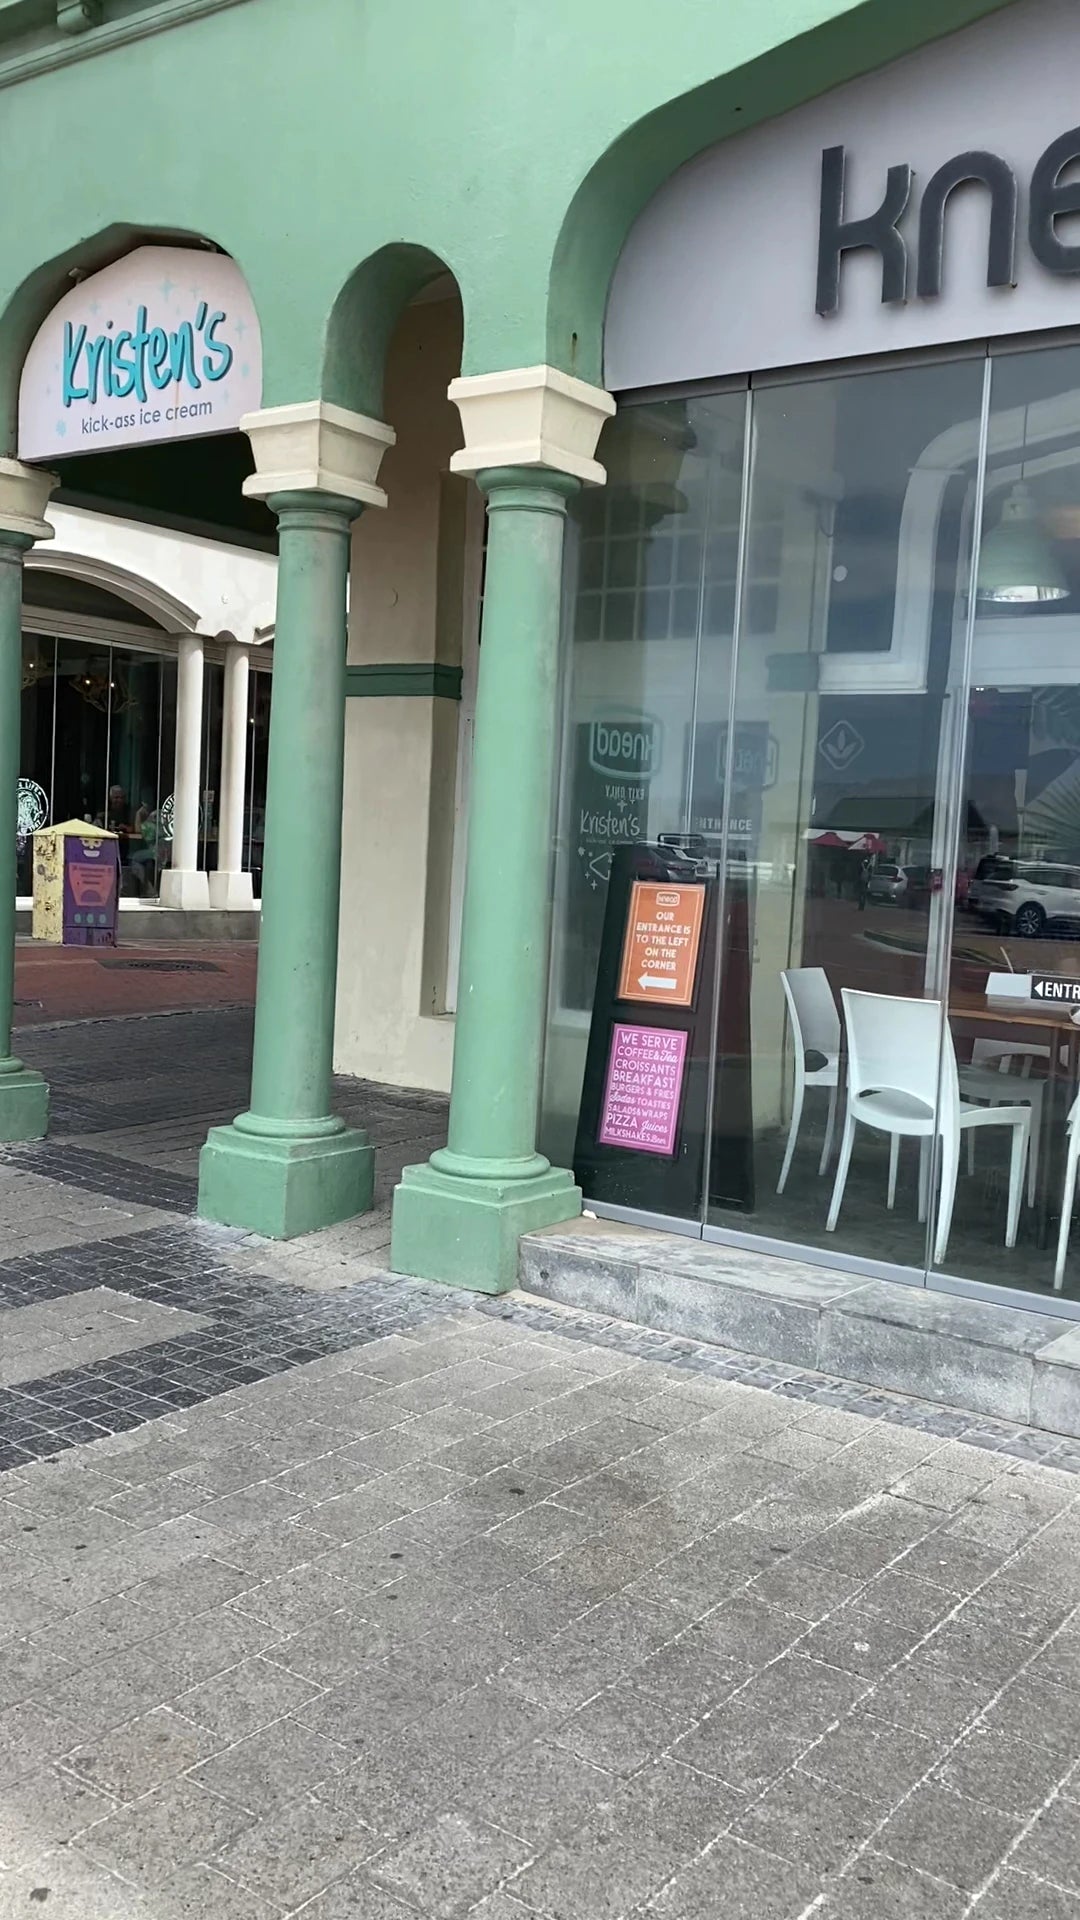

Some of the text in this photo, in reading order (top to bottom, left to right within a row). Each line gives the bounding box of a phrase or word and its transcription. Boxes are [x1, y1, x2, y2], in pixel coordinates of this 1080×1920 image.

[63, 301, 233, 408] Kristen's
[81, 401, 213, 435] kick-ass ice cream
[580, 808, 641, 838] Kristen's
[695, 817, 752, 831] NTRNCE
[656, 911, 675, 921] OUR
[636, 922, 692, 935] ENTRANCE IS
[636, 934, 689, 947] TO THE LEFT
[645, 947, 677, 958] ON THE
[641, 959, 677, 971] CORNER
[1044, 981, 1080, 1000] ENTR
[621, 1032, 679, 1051] WE SERVE
[615, 1058, 676, 1077] CROISSANTS
[613, 1069, 676, 1089] BREAKFAST
[610, 1082, 674, 1100] BURGERS & FRIES
[637, 1097, 671, 1110] TOASTIES
[607, 1113, 638, 1129] PIZZA
[604, 1126, 651, 1142] MILKSHAKES
